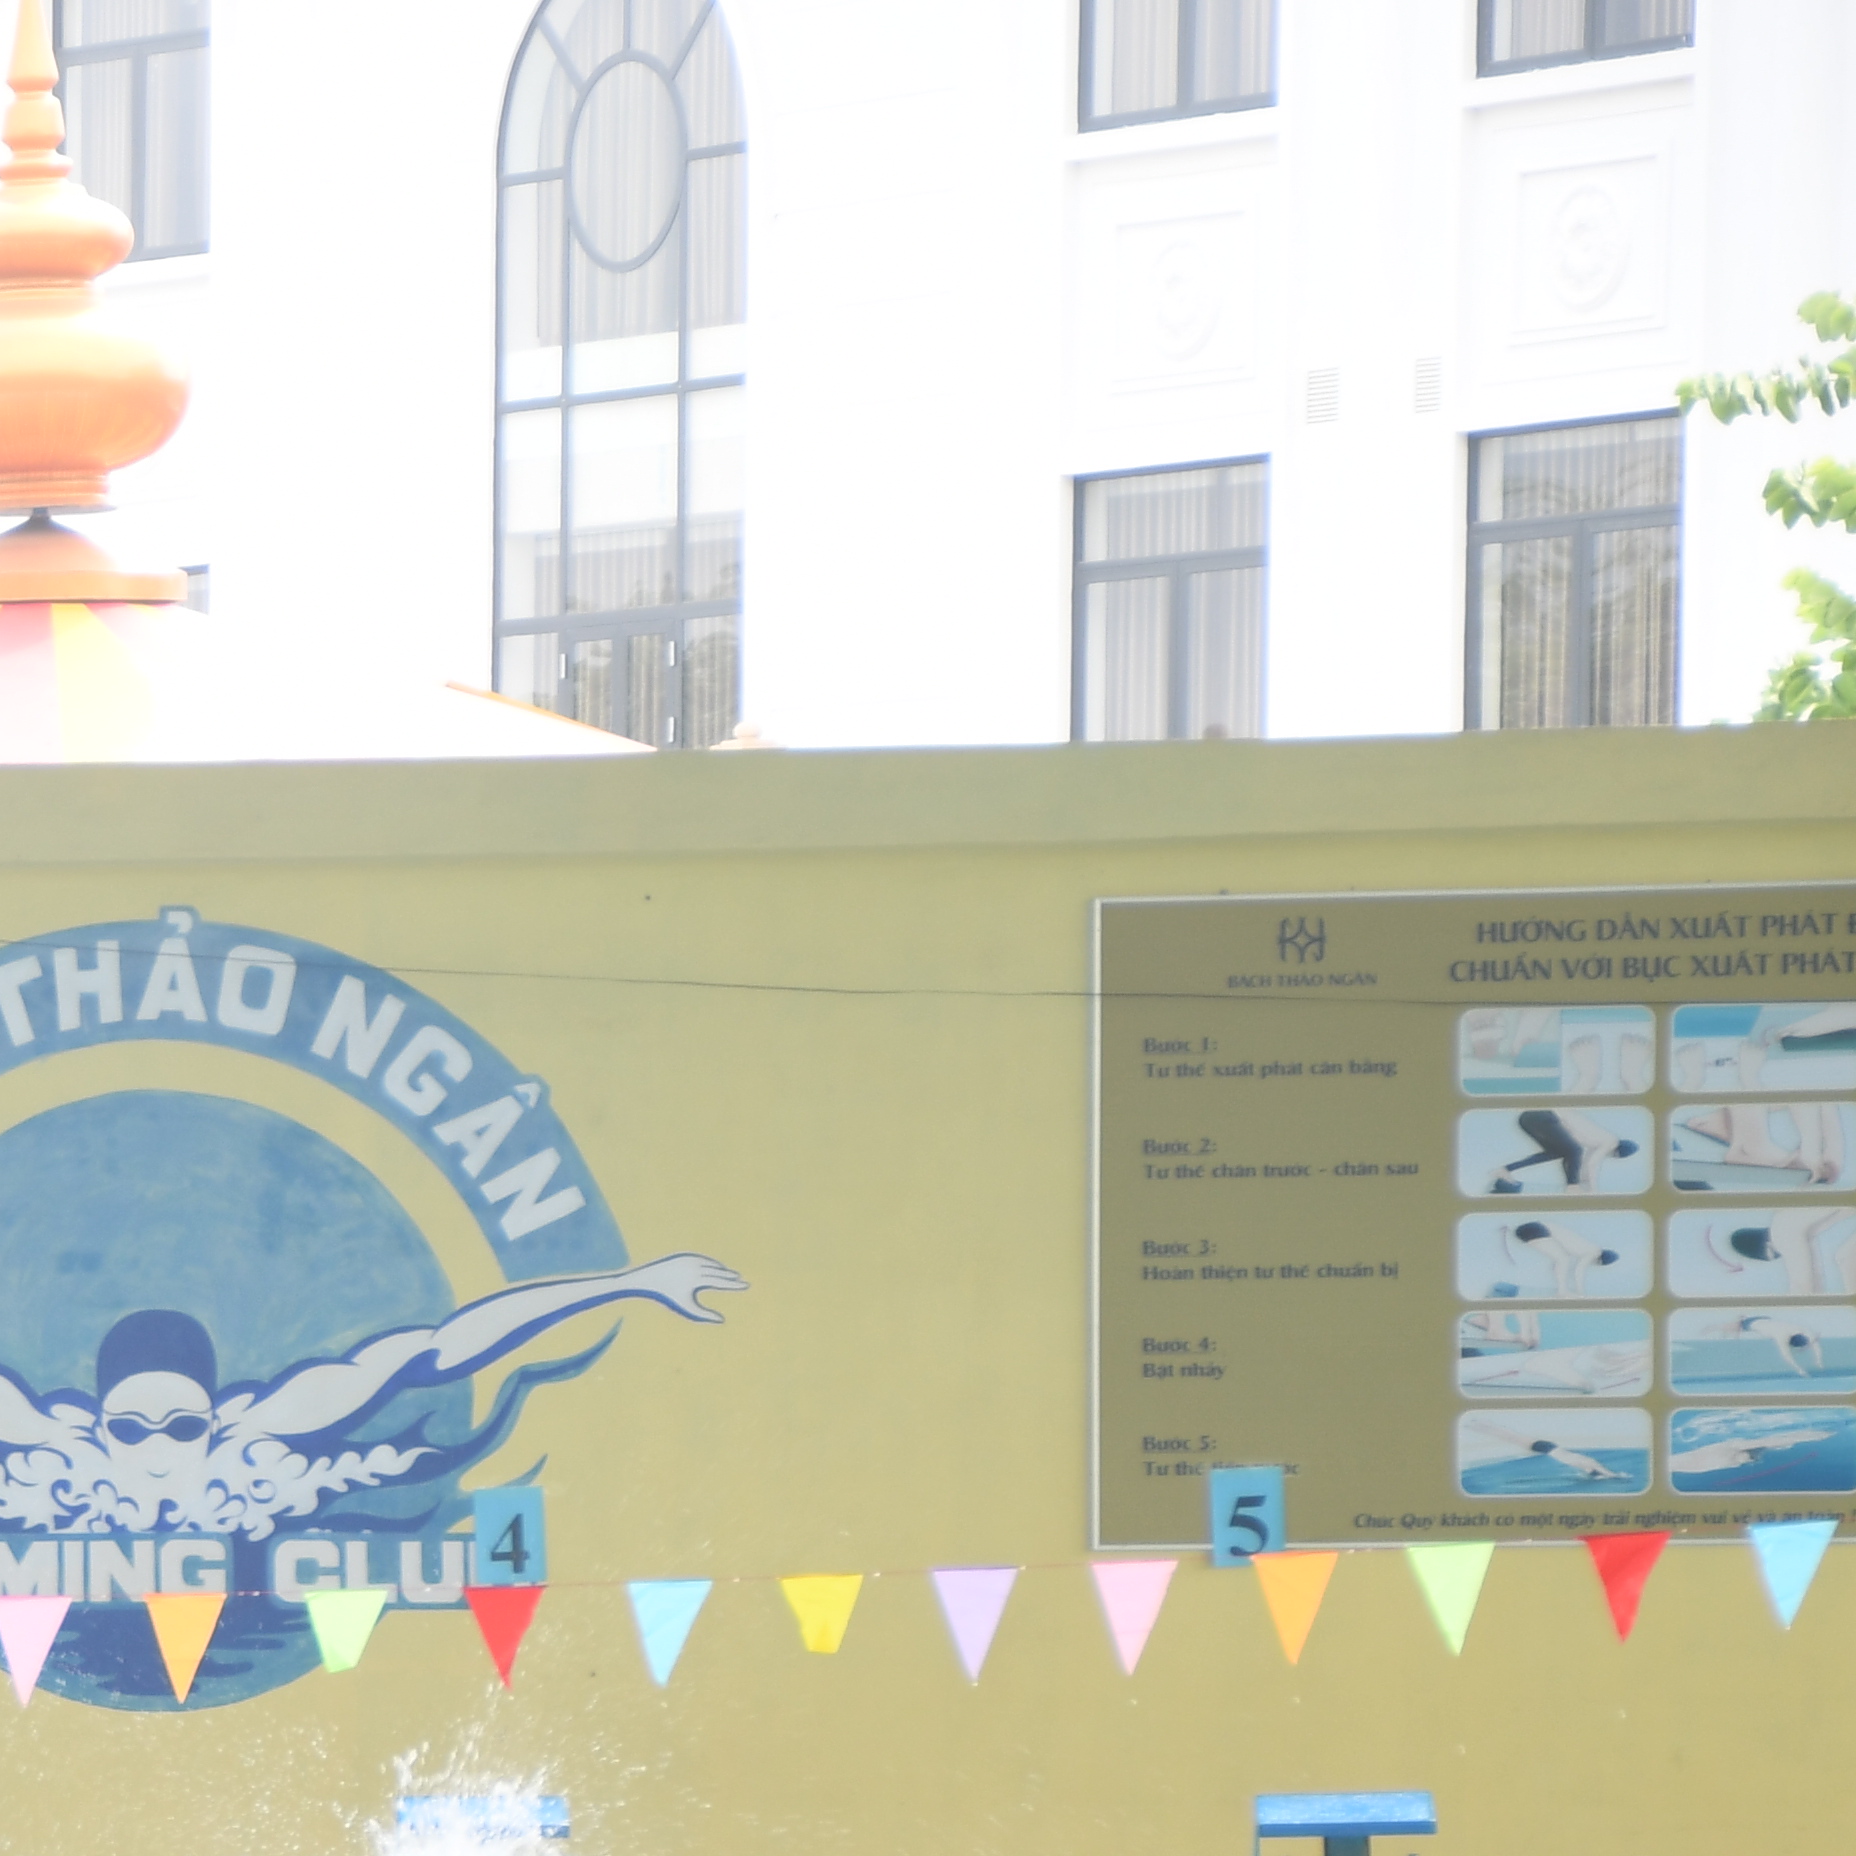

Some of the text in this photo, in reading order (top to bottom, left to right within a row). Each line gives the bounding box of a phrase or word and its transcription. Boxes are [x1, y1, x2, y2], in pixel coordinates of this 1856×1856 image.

[1622, 956, 1680, 982] BỤC
[310, 975, 587, 1243] NGÂN
[490, 1513, 531, 1574] 4
[1226, 1495, 1271, 1556] 5
[274, 1539, 476, 1603] CLU
